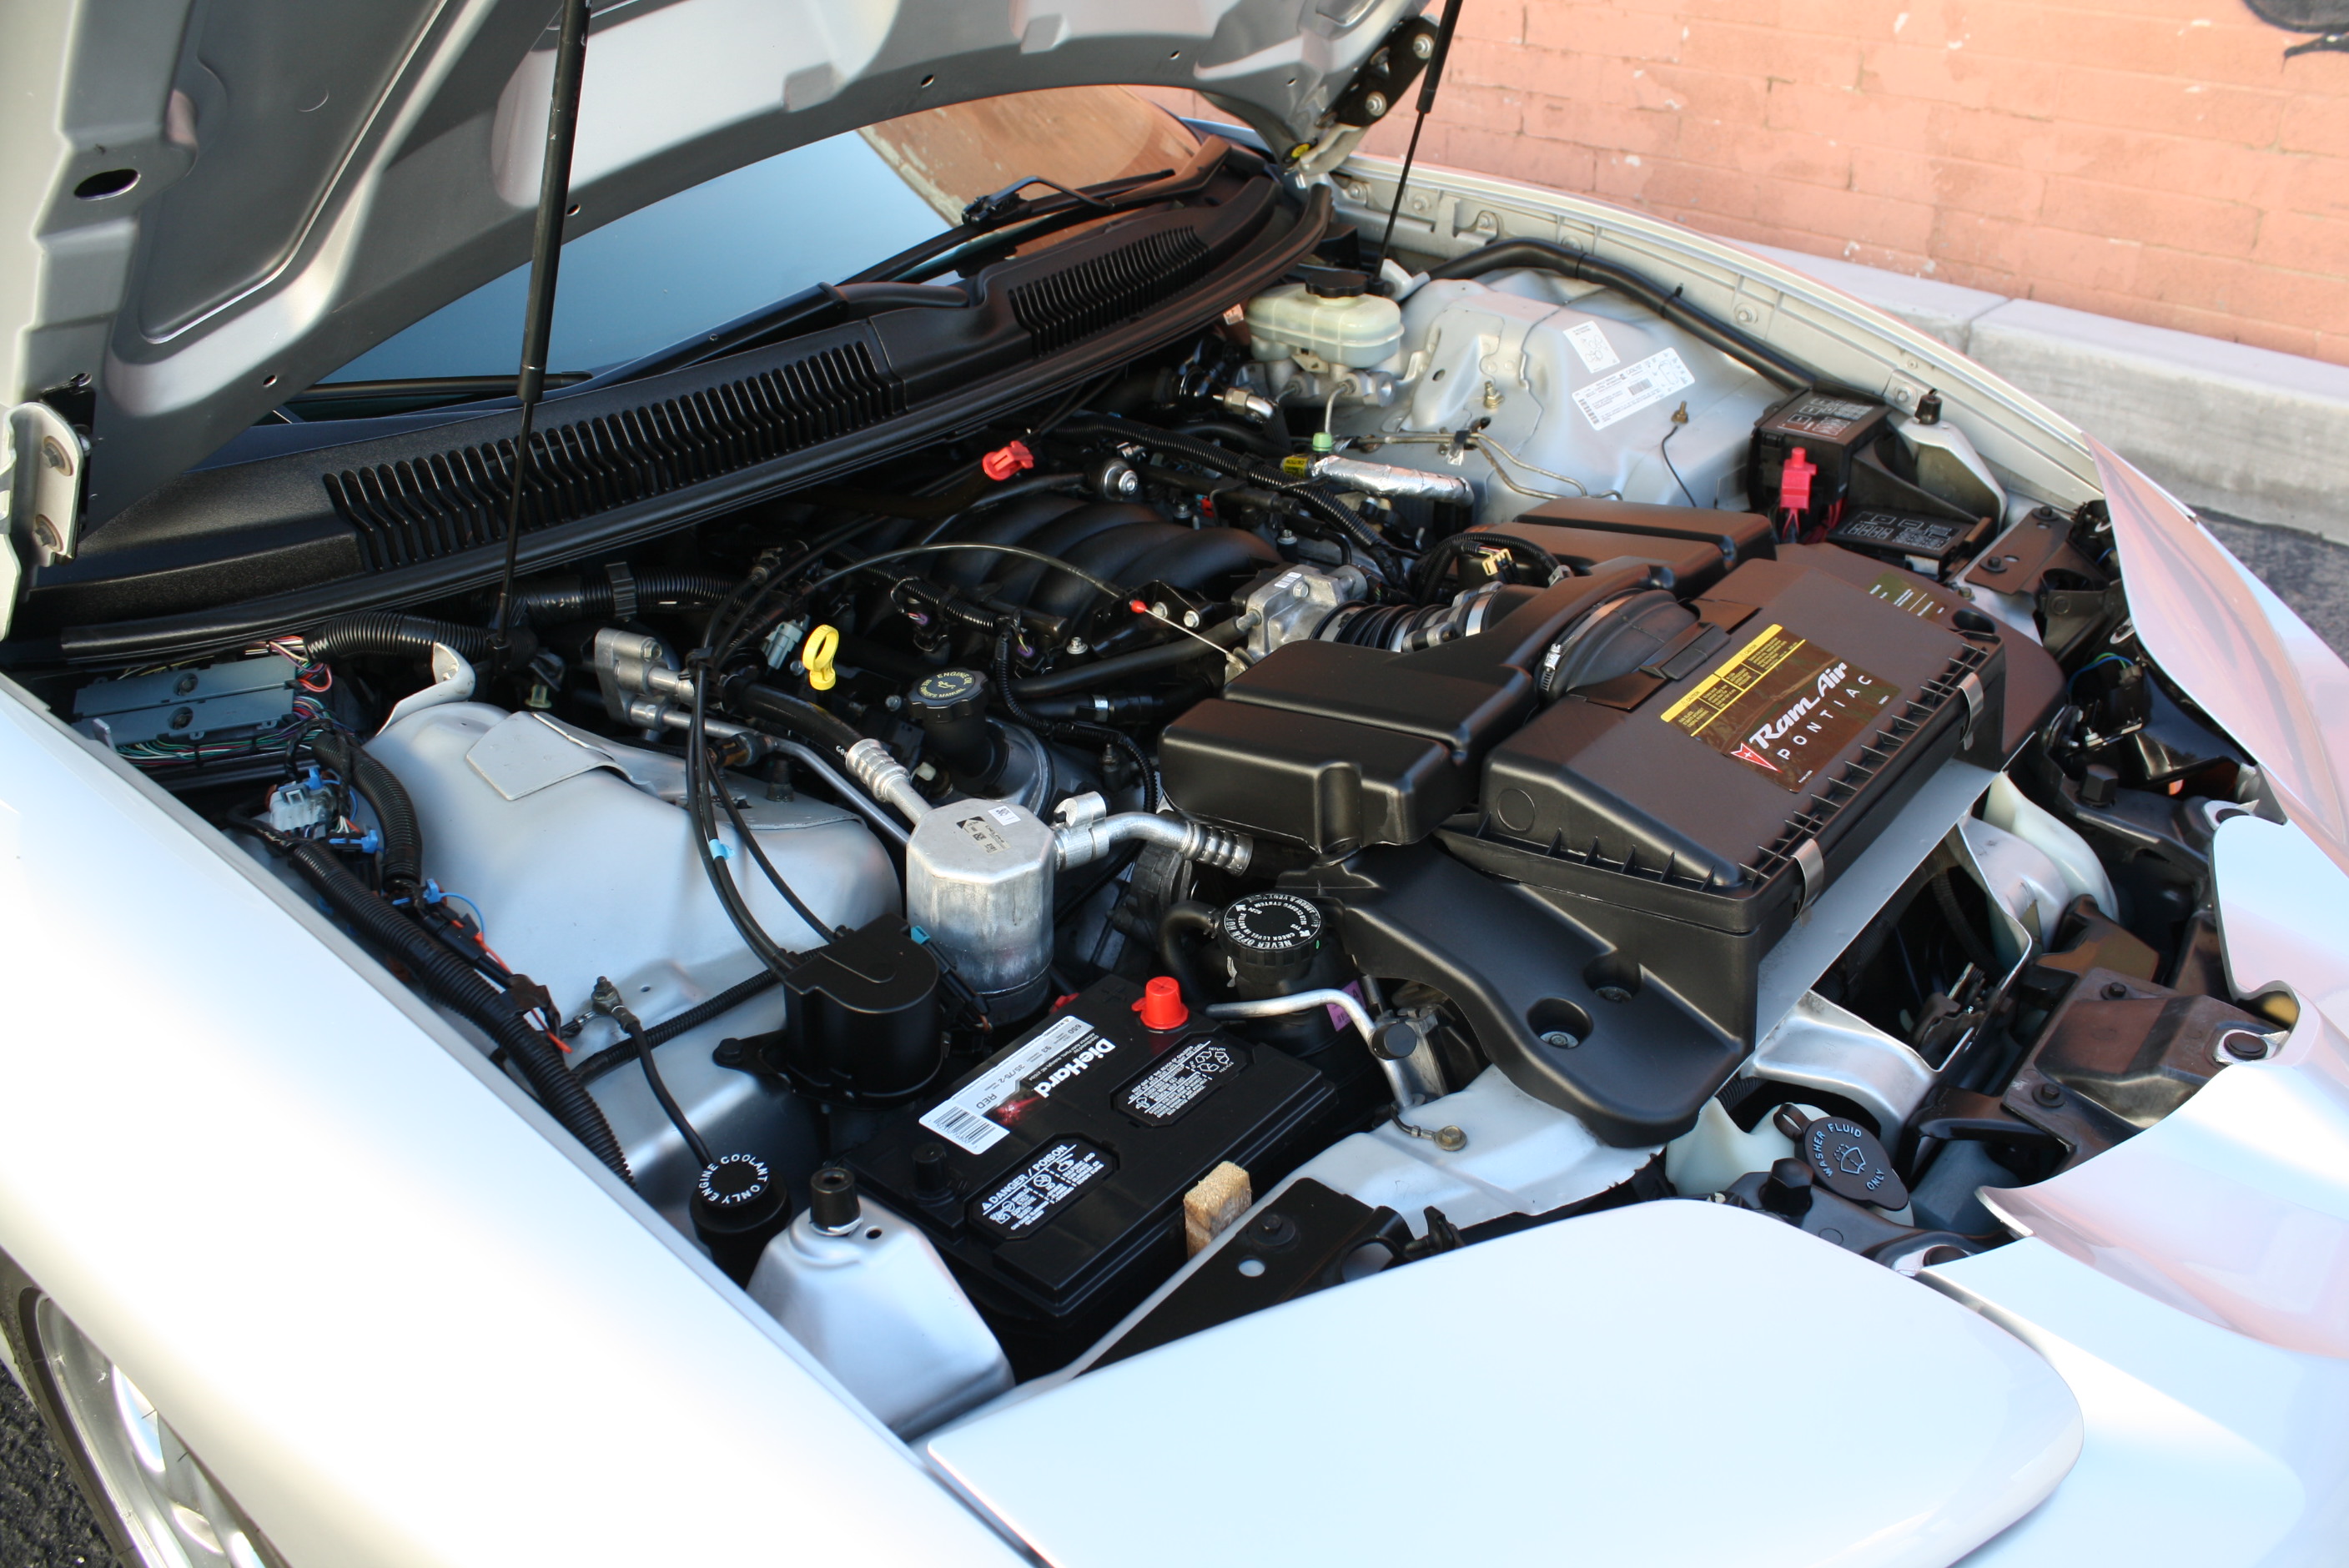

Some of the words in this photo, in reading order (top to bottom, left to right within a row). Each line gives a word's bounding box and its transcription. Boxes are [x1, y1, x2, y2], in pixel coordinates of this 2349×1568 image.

[938, 688, 966, 697] MANUAL
[1685, 690, 1701, 702] CAUTION
[1748, 696, 1820, 750] Ram
[1817, 661, 1848, 698] Air
[1774, 674, 1873, 761] PONTIAC
[1258, 939, 1293, 948] NEVER
[1273, 932, 1295, 940] CHECK
[1065, 1023, 1083, 1035] 650
[1031, 1037, 1116, 1098] DieHard
[974, 1093, 998, 1109] RED
[1813, 1131, 1833, 1178] WASHER
[1827, 1123, 1862, 1138] FLUID
[721, 1154, 768, 1182] COOLANT
[987, 1173, 1029, 1204] DANGER
[1030, 1143, 1069, 1171] POISON
[1866, 1168, 1885, 1190] ONLY
[698, 1163, 719, 1201] ENGINE
[722, 1184, 761, 1204] ONLY
